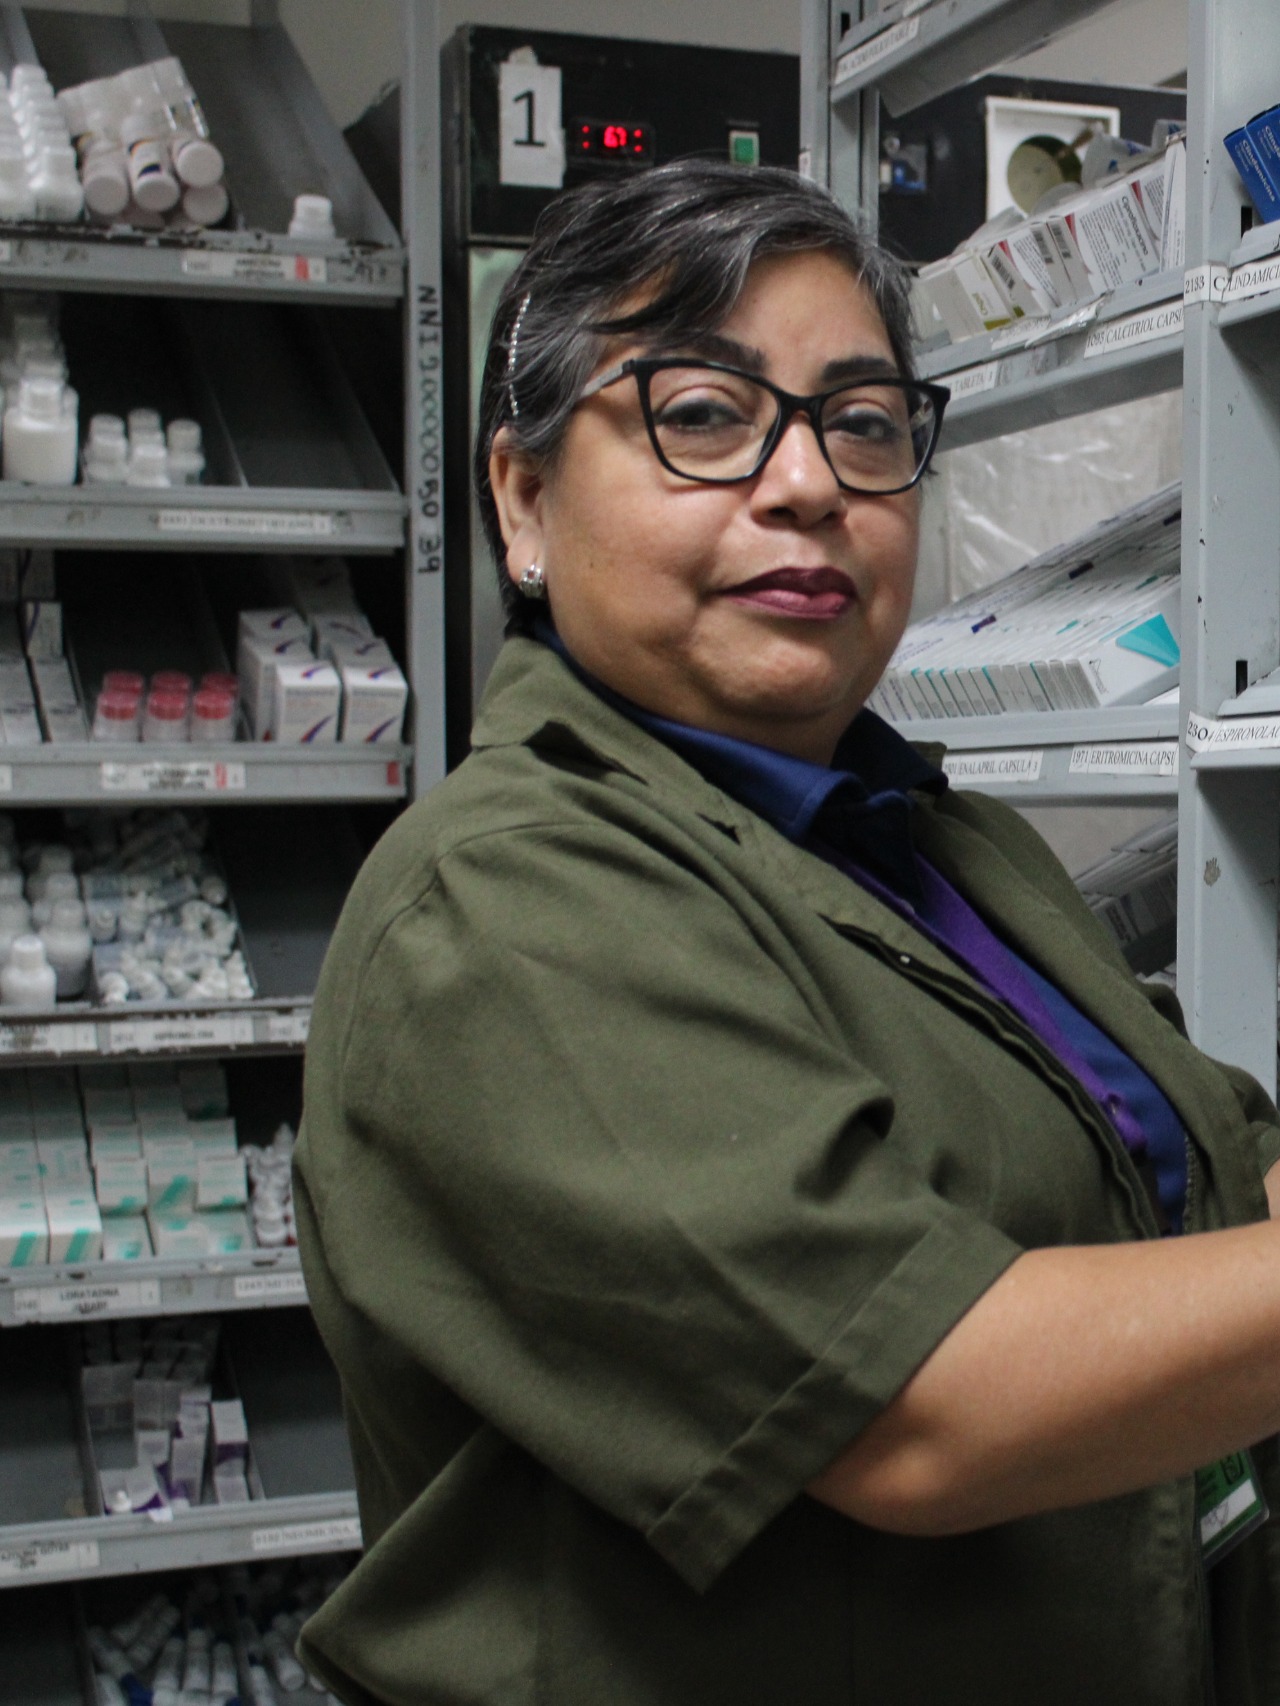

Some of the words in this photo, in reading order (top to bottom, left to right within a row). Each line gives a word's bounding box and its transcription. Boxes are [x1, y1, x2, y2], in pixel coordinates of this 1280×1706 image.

[512, 89, 547, 149] 1
[1242, 138, 1276, 202] Clindamicina
[1106, 318, 1154, 344] CALCITRIOL
[958, 758, 996, 777] ENALAPRIL
[1090, 751, 1149, 767] ERITROMICINA
